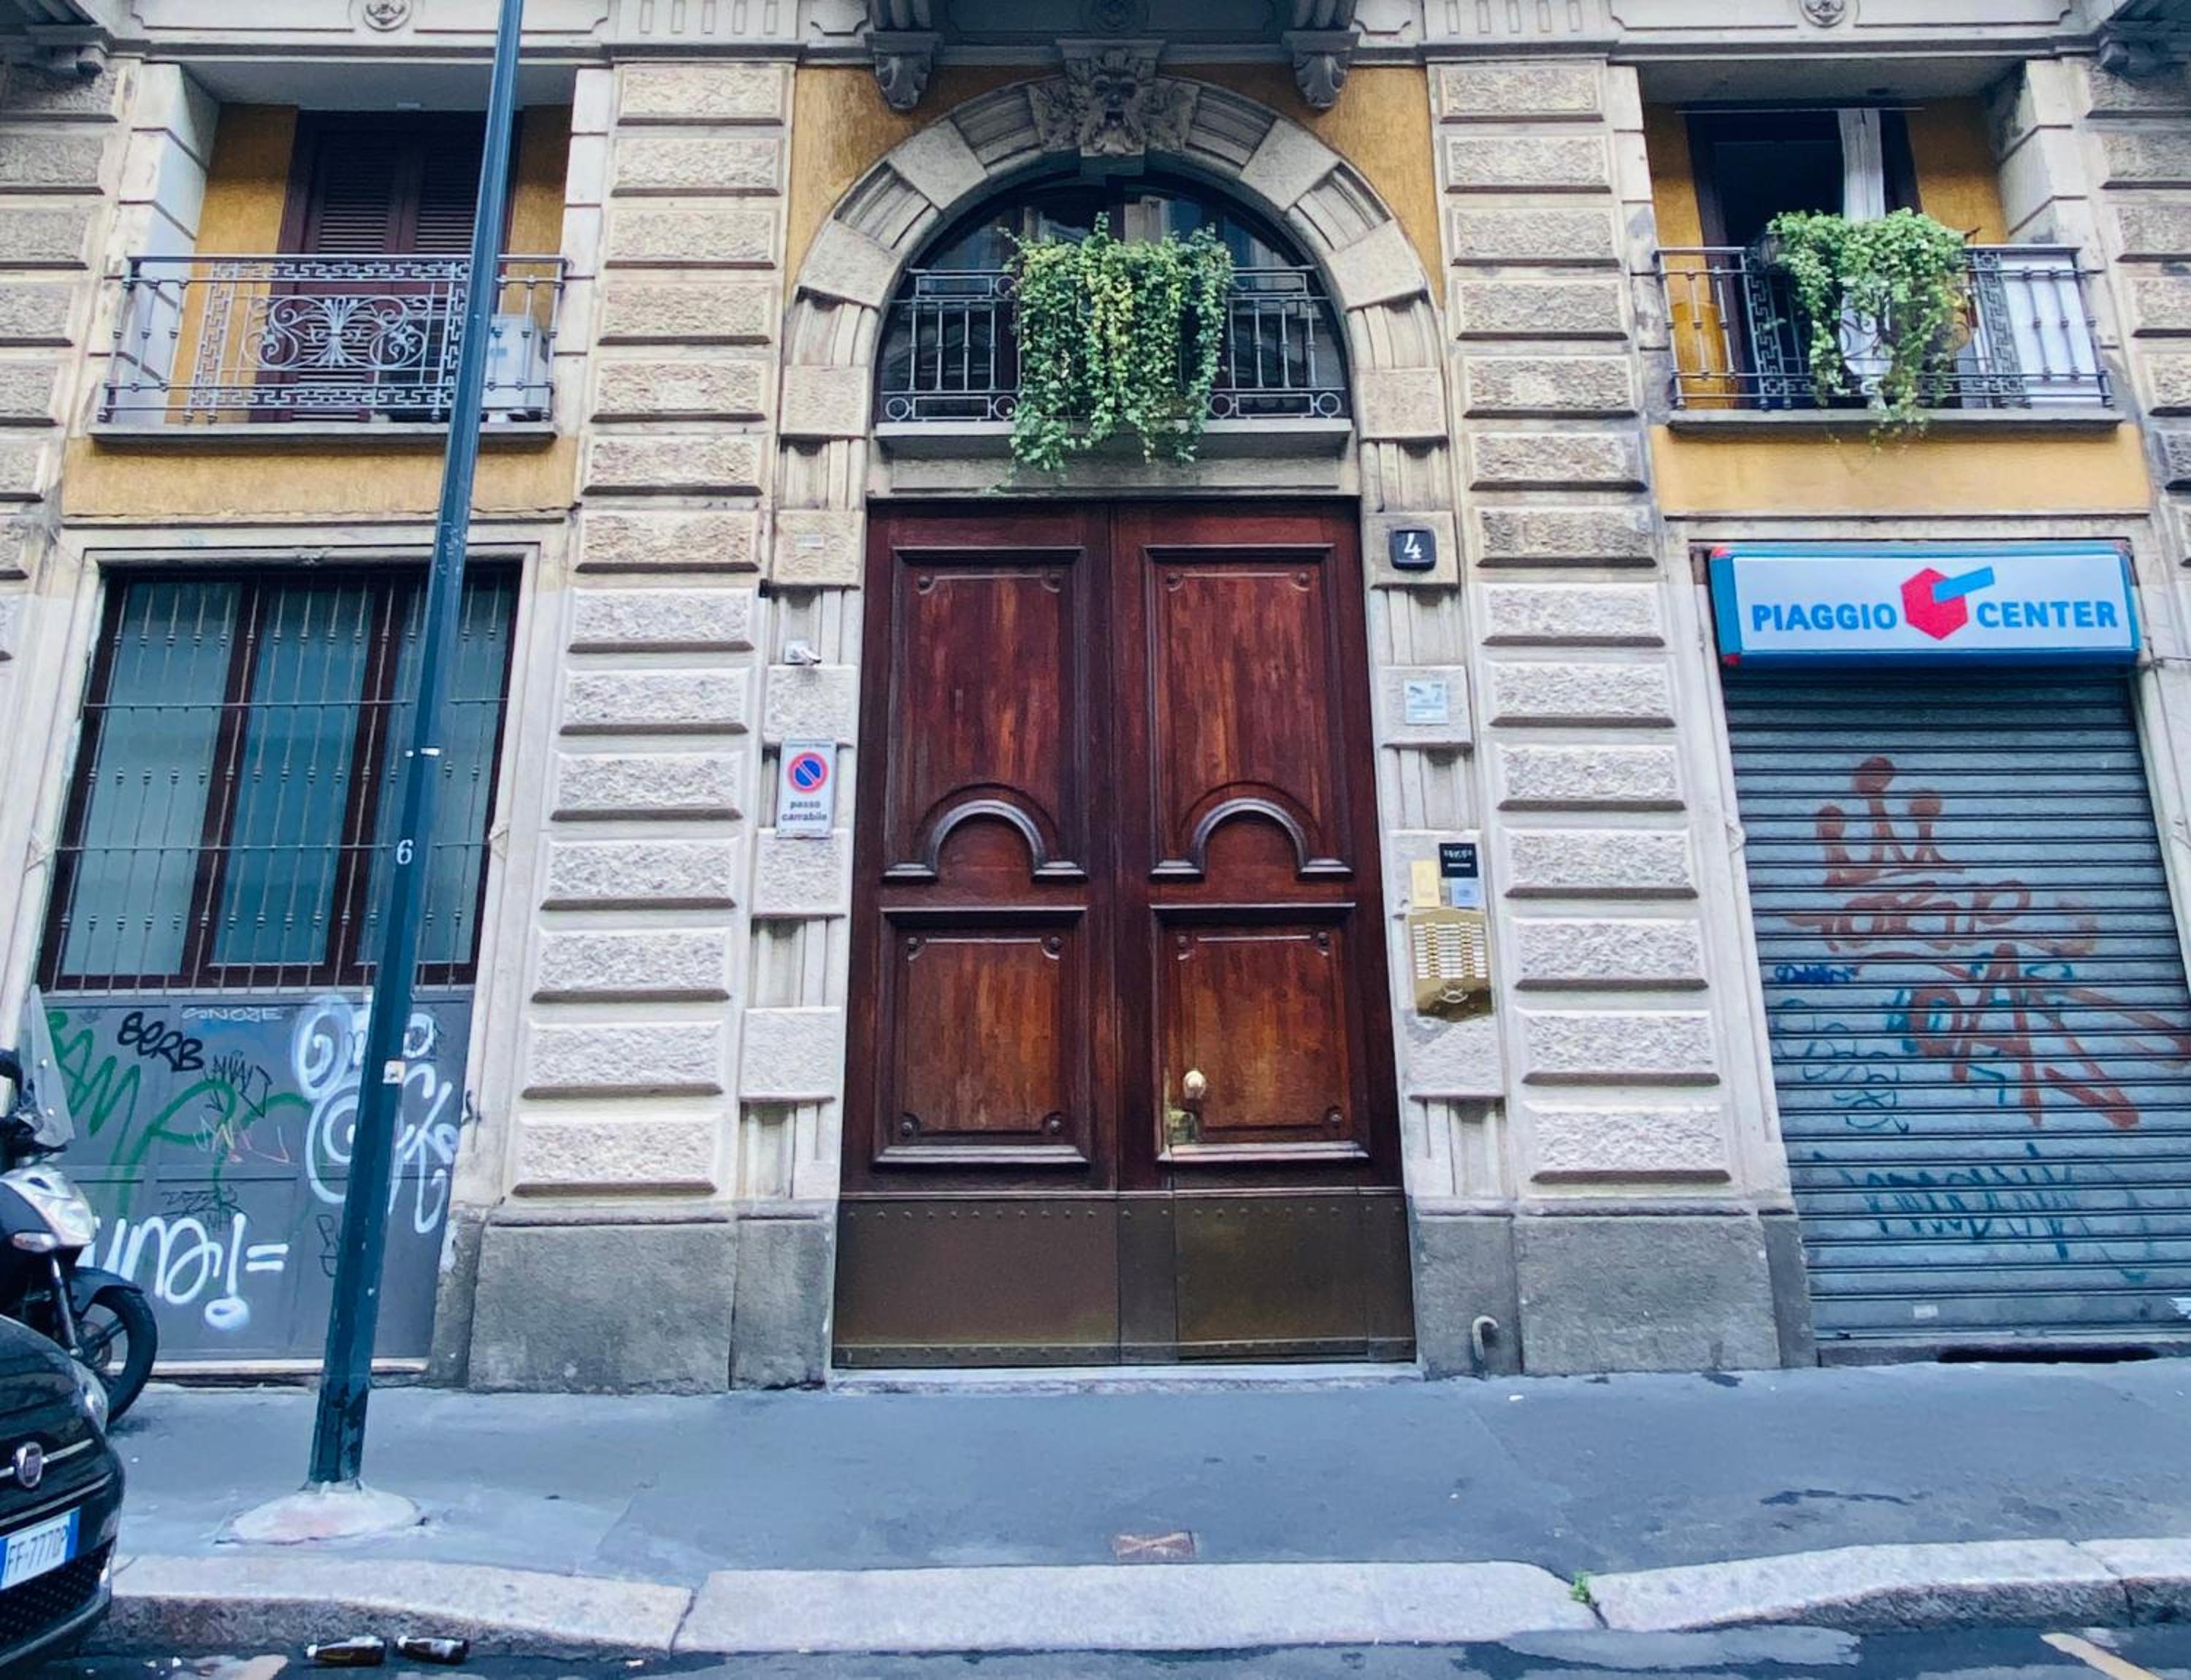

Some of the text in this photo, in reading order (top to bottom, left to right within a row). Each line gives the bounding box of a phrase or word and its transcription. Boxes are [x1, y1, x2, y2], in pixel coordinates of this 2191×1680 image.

[1404, 532, 1422, 559] 4
[1753, 601, 2117, 631] PIAGGIO CENTER
[781, 812, 827, 821] carrabile
[789, 801, 821, 809] passo
[397, 839, 413, 865] 6
